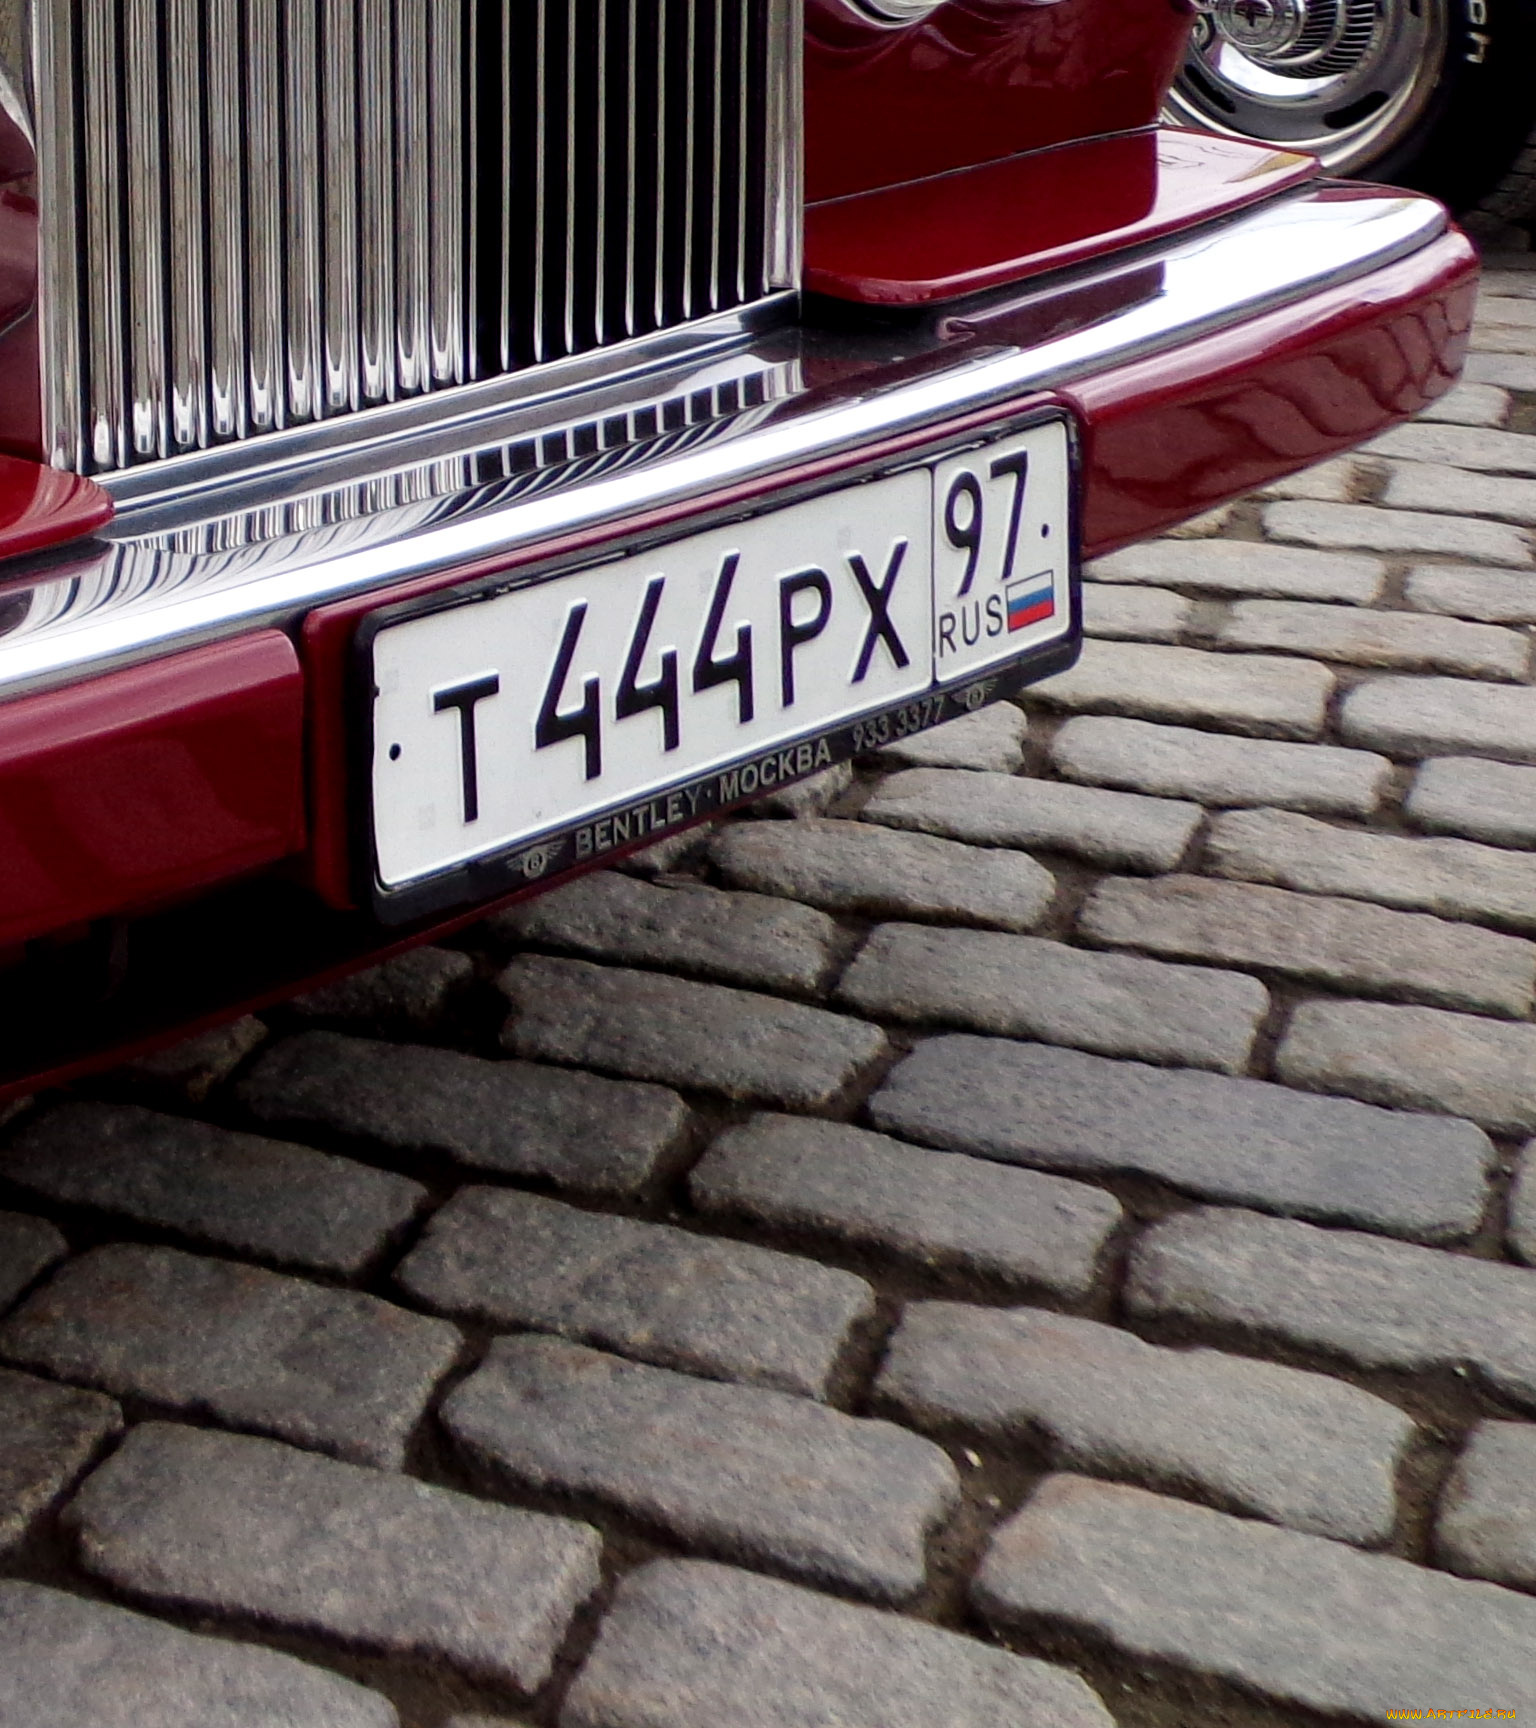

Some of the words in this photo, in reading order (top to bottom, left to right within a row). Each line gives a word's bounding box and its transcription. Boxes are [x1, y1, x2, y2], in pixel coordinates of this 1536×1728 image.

[944, 449, 1028, 599] 97
[939, 593, 1004, 658] RUS
[575, 785, 703, 859] BENTLEY
[719, 737, 832, 804] МОСКВА
[852, 713, 889, 753] 933
